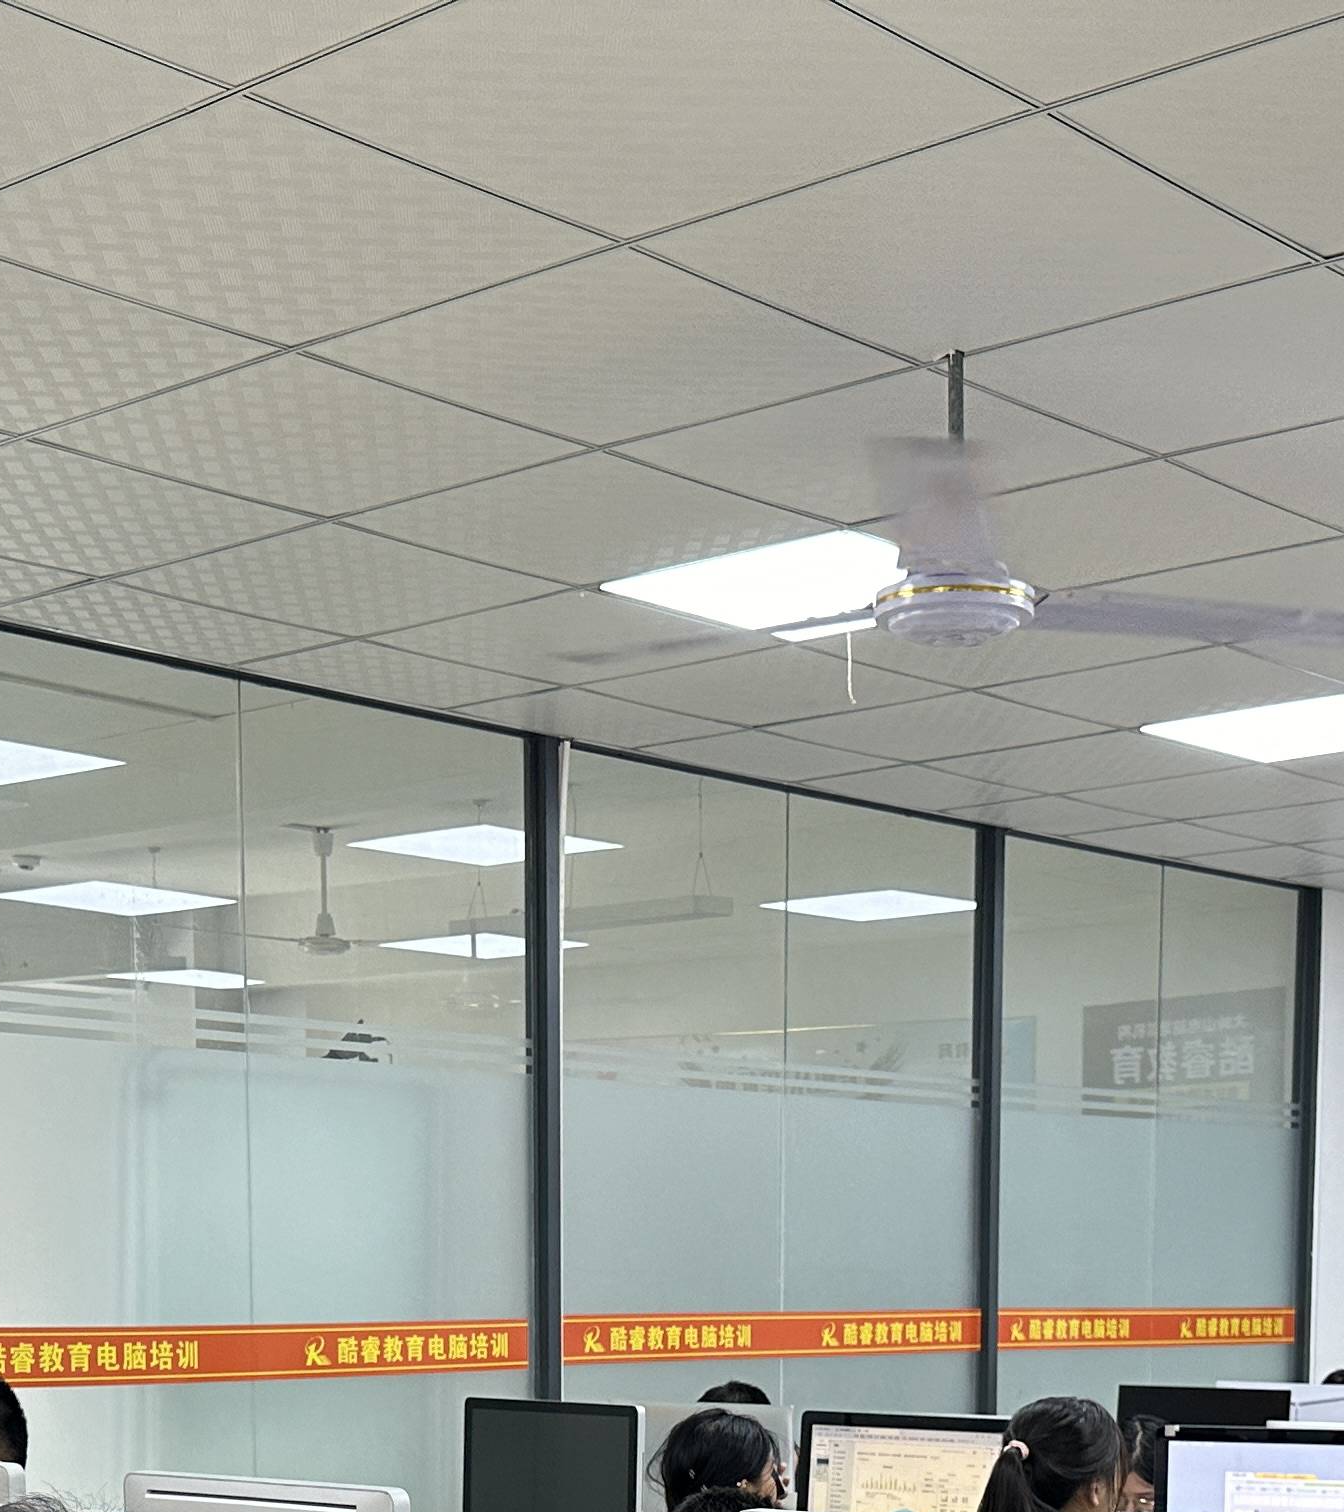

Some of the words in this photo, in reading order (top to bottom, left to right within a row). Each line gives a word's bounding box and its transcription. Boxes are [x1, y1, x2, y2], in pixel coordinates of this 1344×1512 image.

[609, 1324, 752, 1351] 酷睿教育电脑培训
[843, 1320, 962, 1346] 酷睿教育电脑培训
[1029, 1318, 1131, 1340] 酷睿教育电脑培训
[1195, 1316, 1284, 1338] 酷睿教育电脑培训
[337, 1332, 509, 1364] 酷睿教育电脑培训
